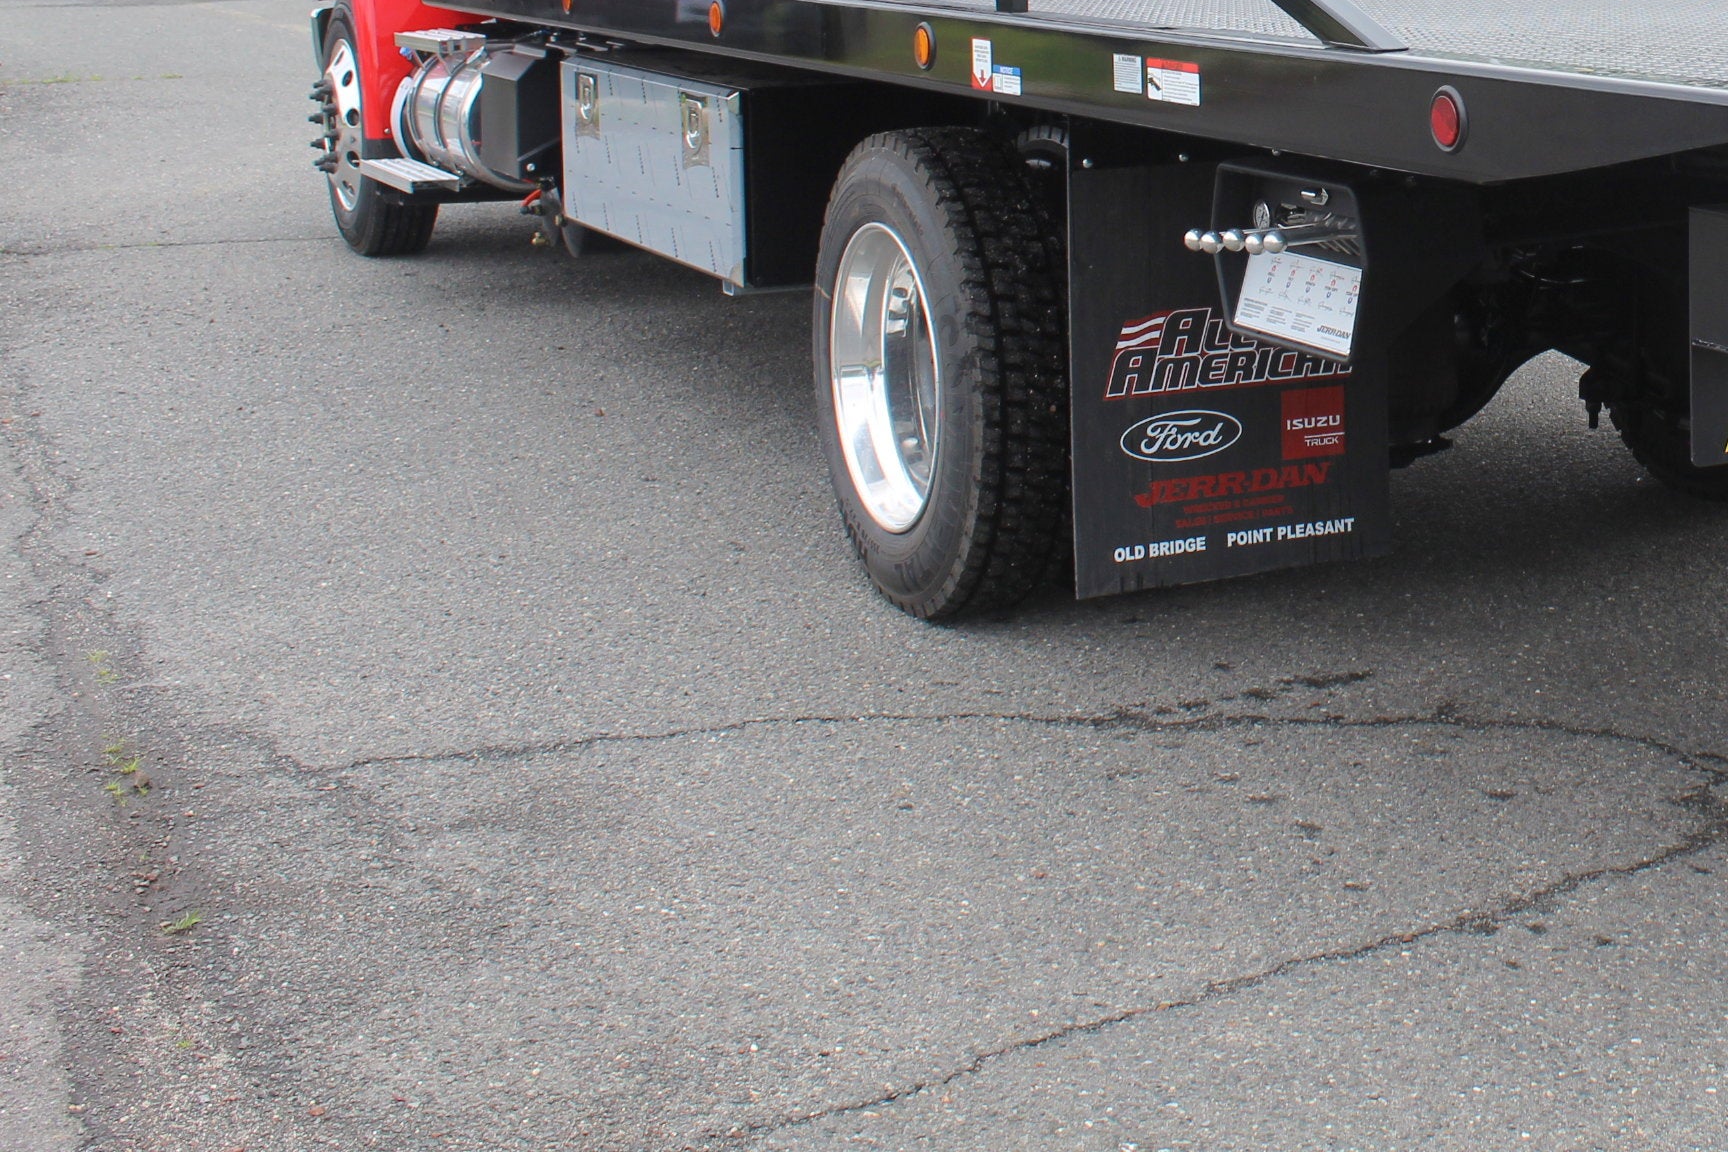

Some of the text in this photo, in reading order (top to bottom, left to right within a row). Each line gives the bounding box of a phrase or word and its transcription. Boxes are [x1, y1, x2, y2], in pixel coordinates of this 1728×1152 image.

[1140, 417, 1224, 454] Ford
[1286, 414, 1341, 431] ISUZU
[1304, 435, 1339, 447] TRUCK
[1113, 517, 1355, 563] OLD BRIDGE POINT PLEASANT
